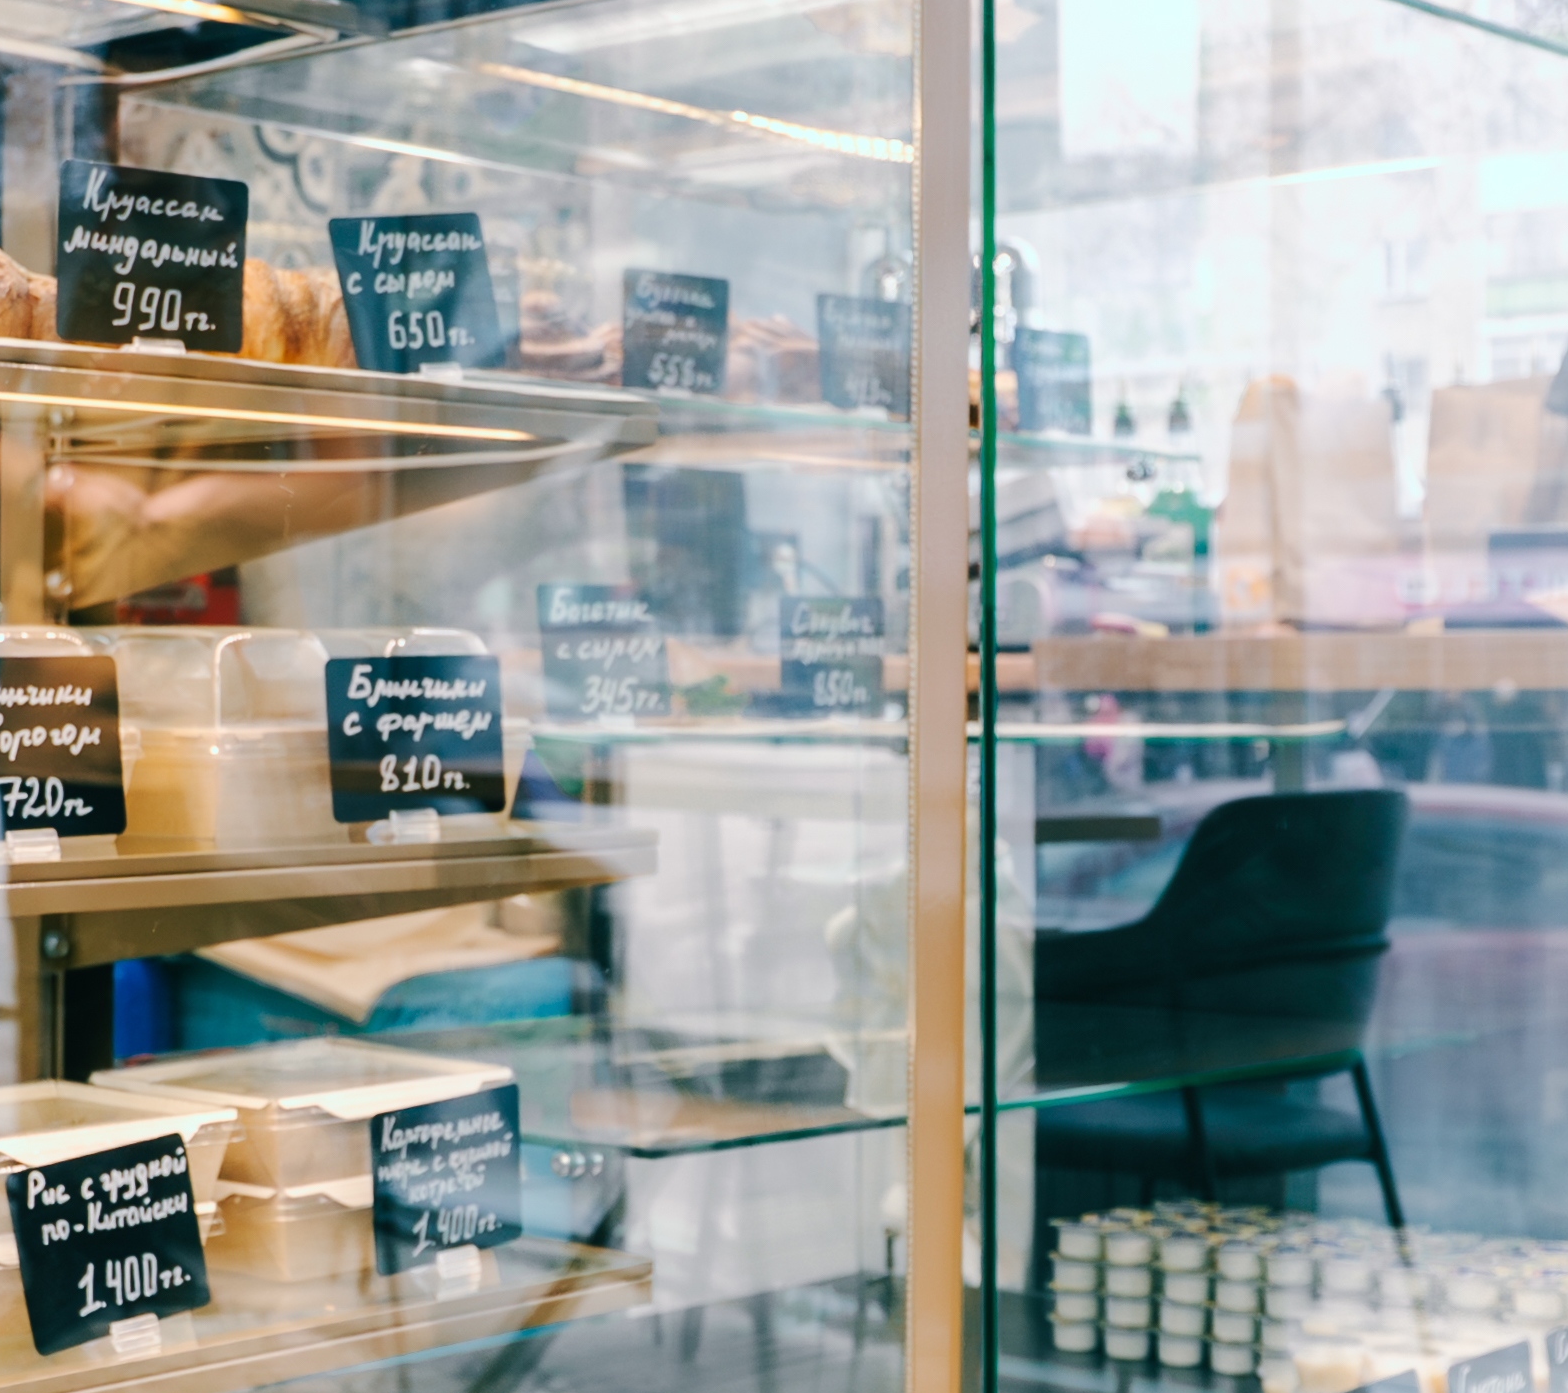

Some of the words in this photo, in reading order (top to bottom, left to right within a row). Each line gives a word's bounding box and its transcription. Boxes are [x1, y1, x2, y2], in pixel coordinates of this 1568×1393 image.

[82, 166, 225, 223] Круассан
[63, 224, 239, 276] миндальный
[357, 219, 483, 270] Круассан
[373, 269, 456, 300] сыром
[346, 663, 487, 709] Блинчики
[375, 708, 493, 743] фаршем
[27, 1169, 71, 1210] Рис
[98, 1145, 188, 1204] грудкой
